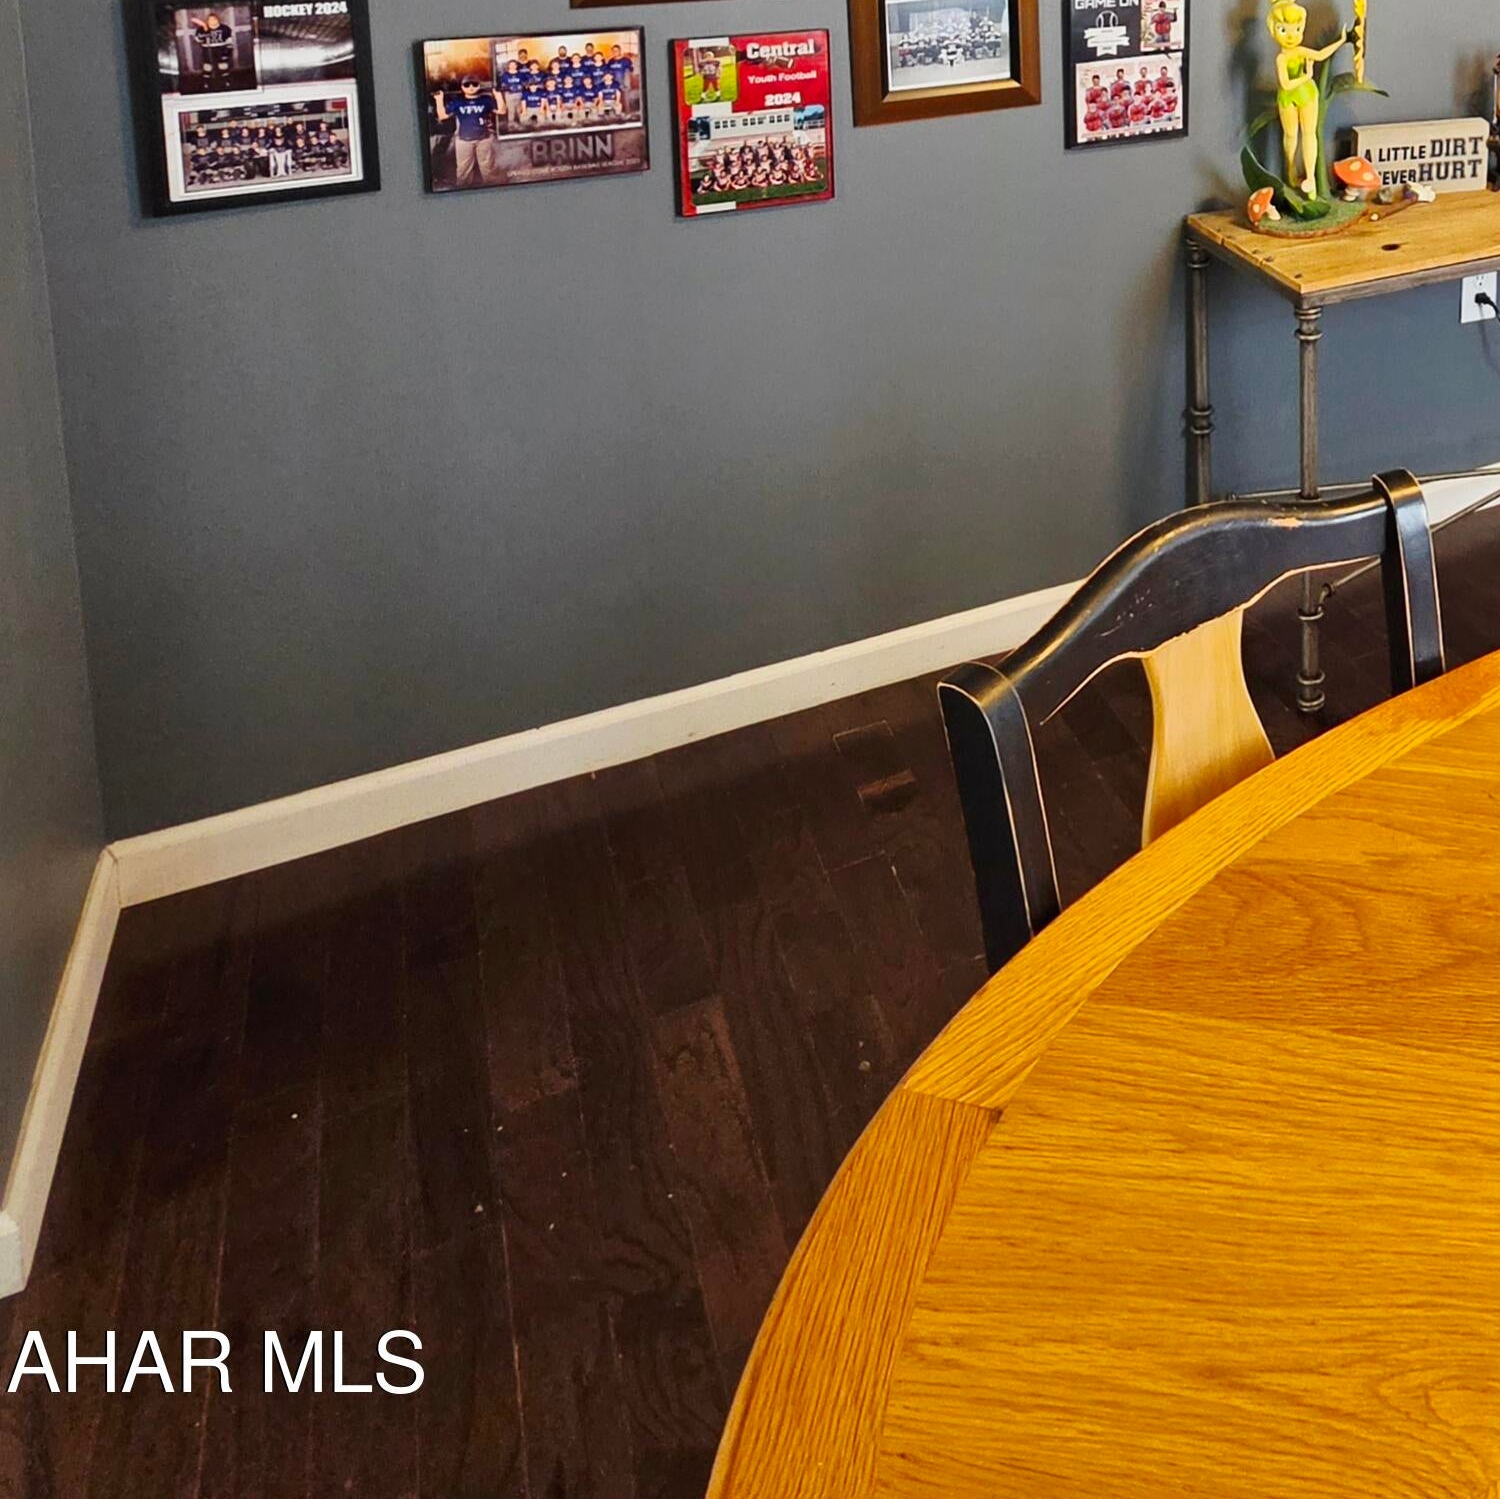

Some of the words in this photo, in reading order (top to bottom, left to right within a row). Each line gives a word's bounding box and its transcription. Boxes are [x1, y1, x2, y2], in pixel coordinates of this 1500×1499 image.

[263, 3, 313, 19] HOCKEY
[315, 1, 348, 15] 2024
[745, 39, 815, 60] Central
[778, 69, 817, 82] Football
[764, 91, 801, 107] 2024
[531, 133, 613, 164] BRINN
[1378, 145, 1427, 163] LITTLE
[1429, 136, 1485, 158] DIRT
[1380, 169, 1417, 186] EVER
[1417, 160, 1483, 183] HURT
